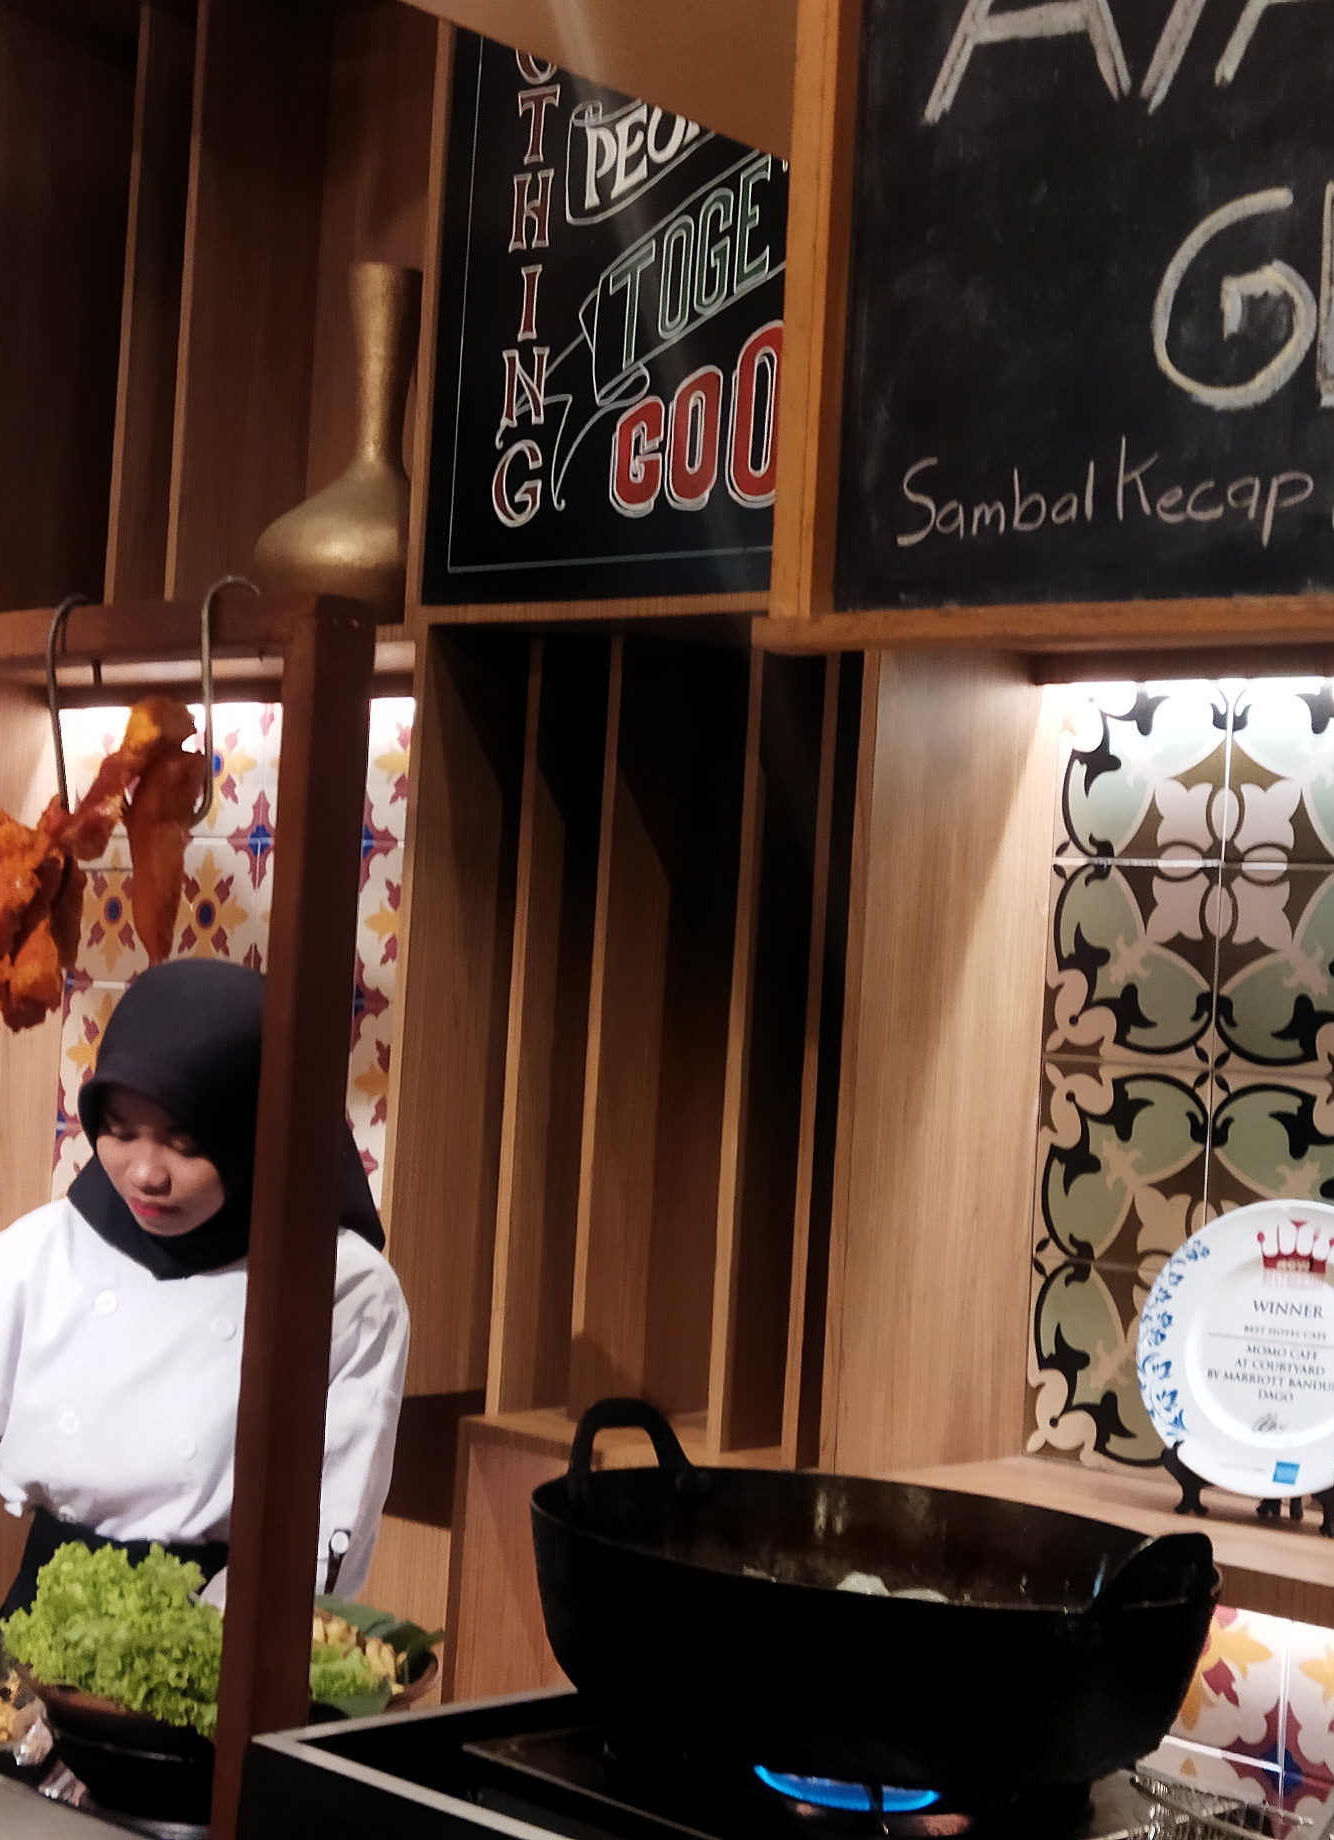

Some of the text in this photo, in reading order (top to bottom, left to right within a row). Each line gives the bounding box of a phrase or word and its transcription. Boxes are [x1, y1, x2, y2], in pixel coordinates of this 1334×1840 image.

[584, 104, 701, 211] PEO
[608, 153, 788, 371] TOGE
[896, 455, 1095, 547] Sambal
[1117, 433, 1315, 548] Kecap
[1252, 1299, 1324, 1319] WINNER
[1243, 1324, 1266, 1334] BEST
[1268, 1327, 1300, 1338] HOTEL
[1246, 1345, 1287, 1358] MOMO
[1235, 1357, 1326, 1376] AT COURTYARD
[1207, 1368, 1221, 1380] BY
[1223, 1369, 1284, 1386] MARRIOTT
[1258, 1388, 1294, 1402] DAGO
